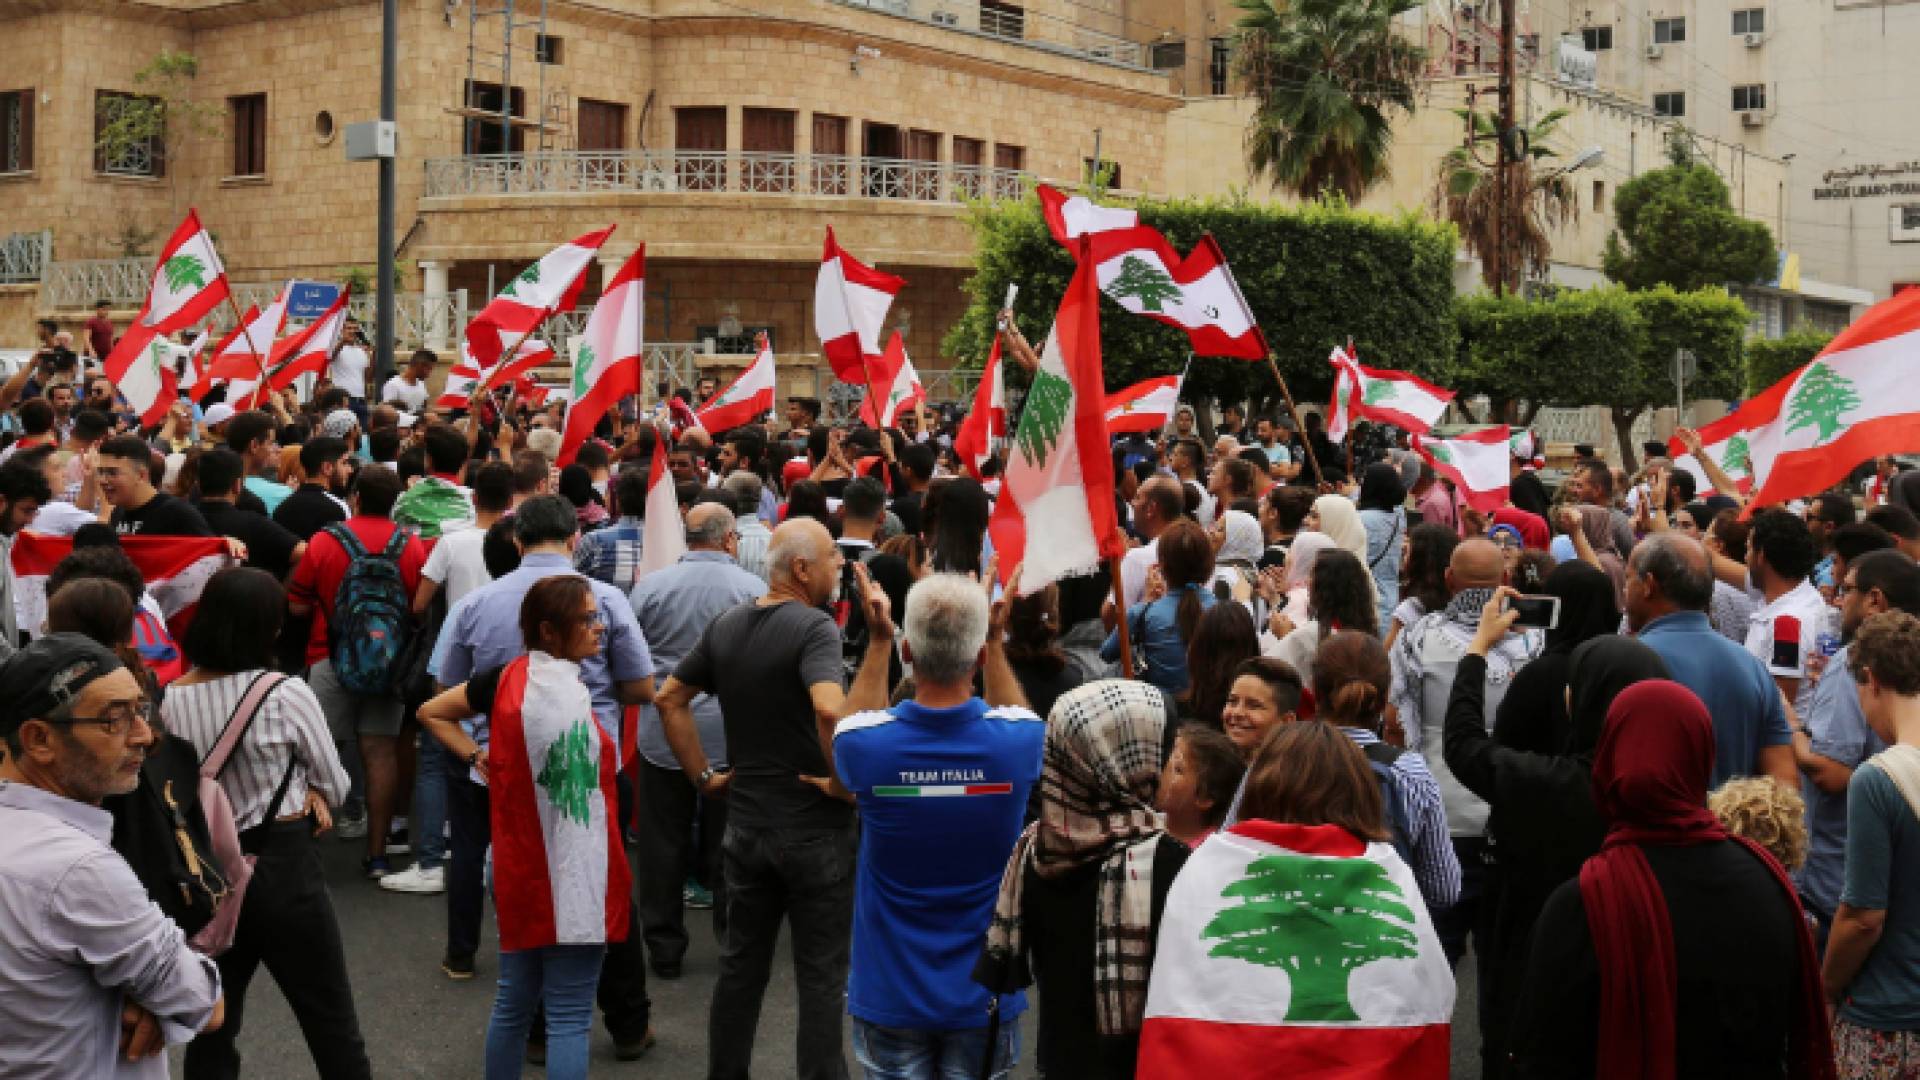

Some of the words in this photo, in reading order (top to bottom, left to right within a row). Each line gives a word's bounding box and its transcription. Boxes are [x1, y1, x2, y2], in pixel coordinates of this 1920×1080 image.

[1813, 187, 1849, 199] BANQUE
[899, 771, 938, 783] TEAM
[942, 769, 985, 781] ITALIA
